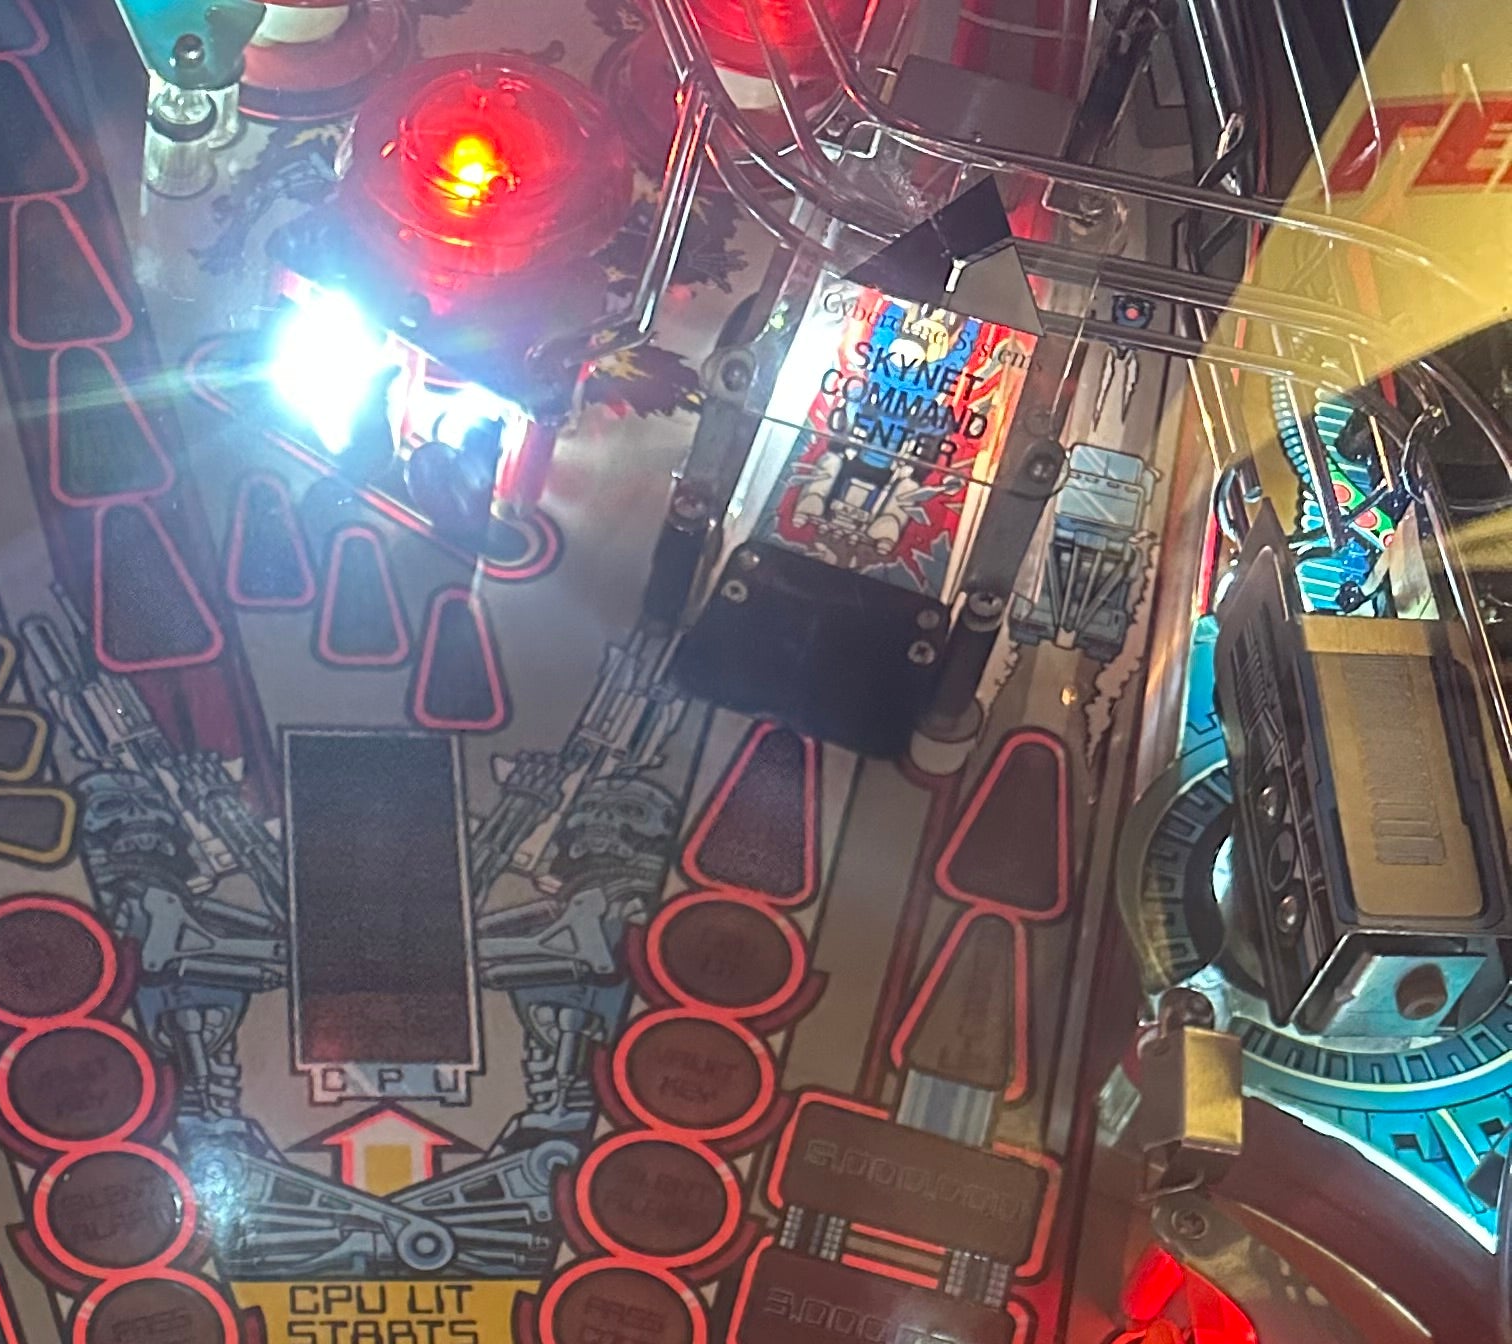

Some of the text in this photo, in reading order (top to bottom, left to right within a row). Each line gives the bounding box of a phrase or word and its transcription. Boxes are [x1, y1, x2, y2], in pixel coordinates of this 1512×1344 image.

[855, 341, 984, 401] SKYNET
[821, 368, 988, 439] COMMAND
[827, 406, 958, 468] CENTER
[320, 1067, 460, 1096] CPU
[289, 1284, 474, 1315] CPU LIT
